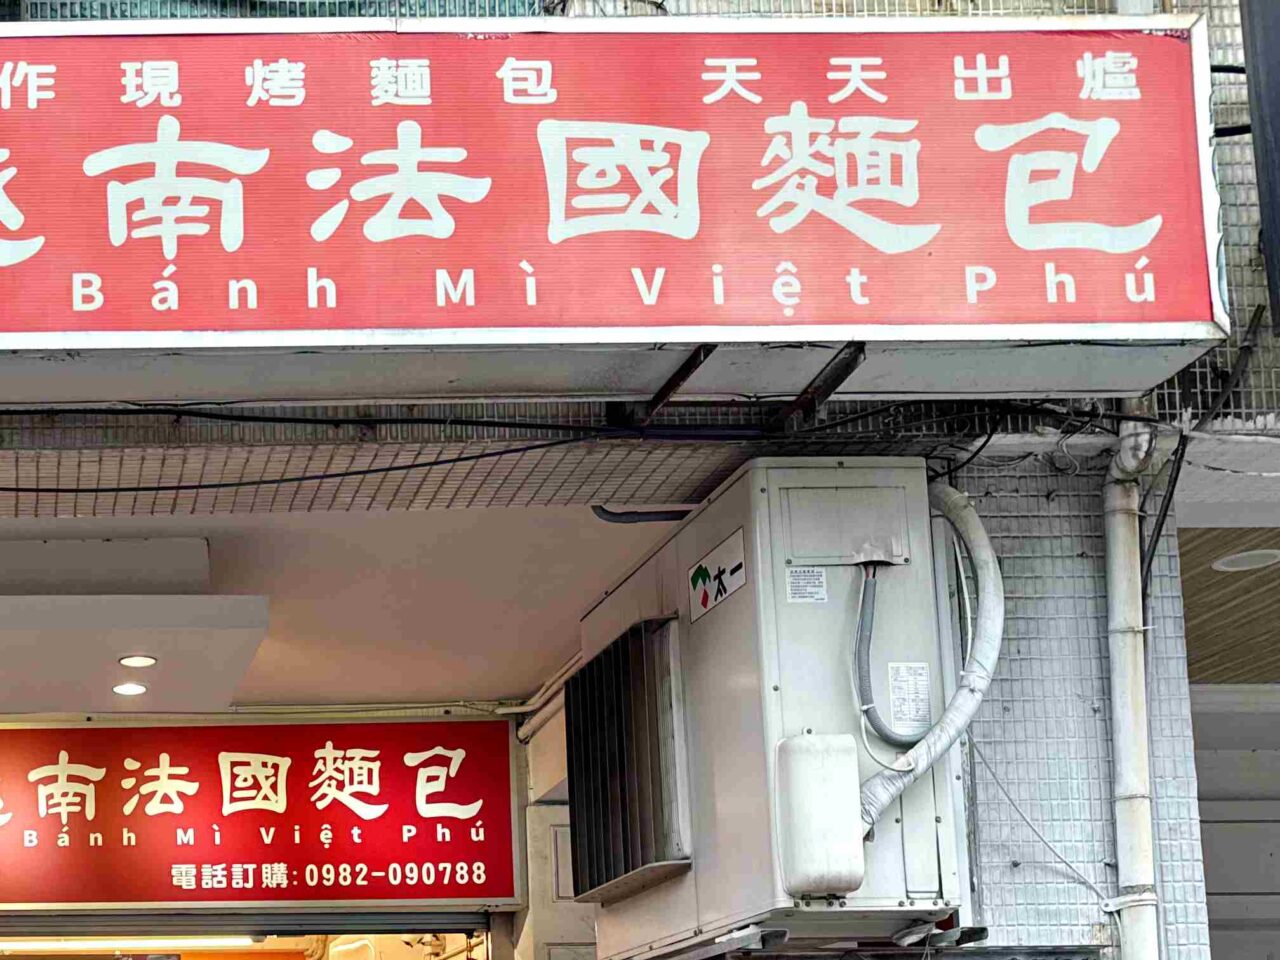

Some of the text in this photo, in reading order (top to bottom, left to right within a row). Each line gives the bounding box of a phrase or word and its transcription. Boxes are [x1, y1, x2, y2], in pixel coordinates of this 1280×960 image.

[701, 51, 1142, 103] 天天出爐
[72, 265, 337, 312] Bánh
[435, 260, 537, 307] Mì
[631, 262, 870, 317] Việt
[965, 255, 1156, 305] Phú
[23, 827, 137, 848] Bánh
[176, 823, 221, 845] Mì
[260, 824, 363, 849] Việt
[402, 820, 486, 843] Phú
